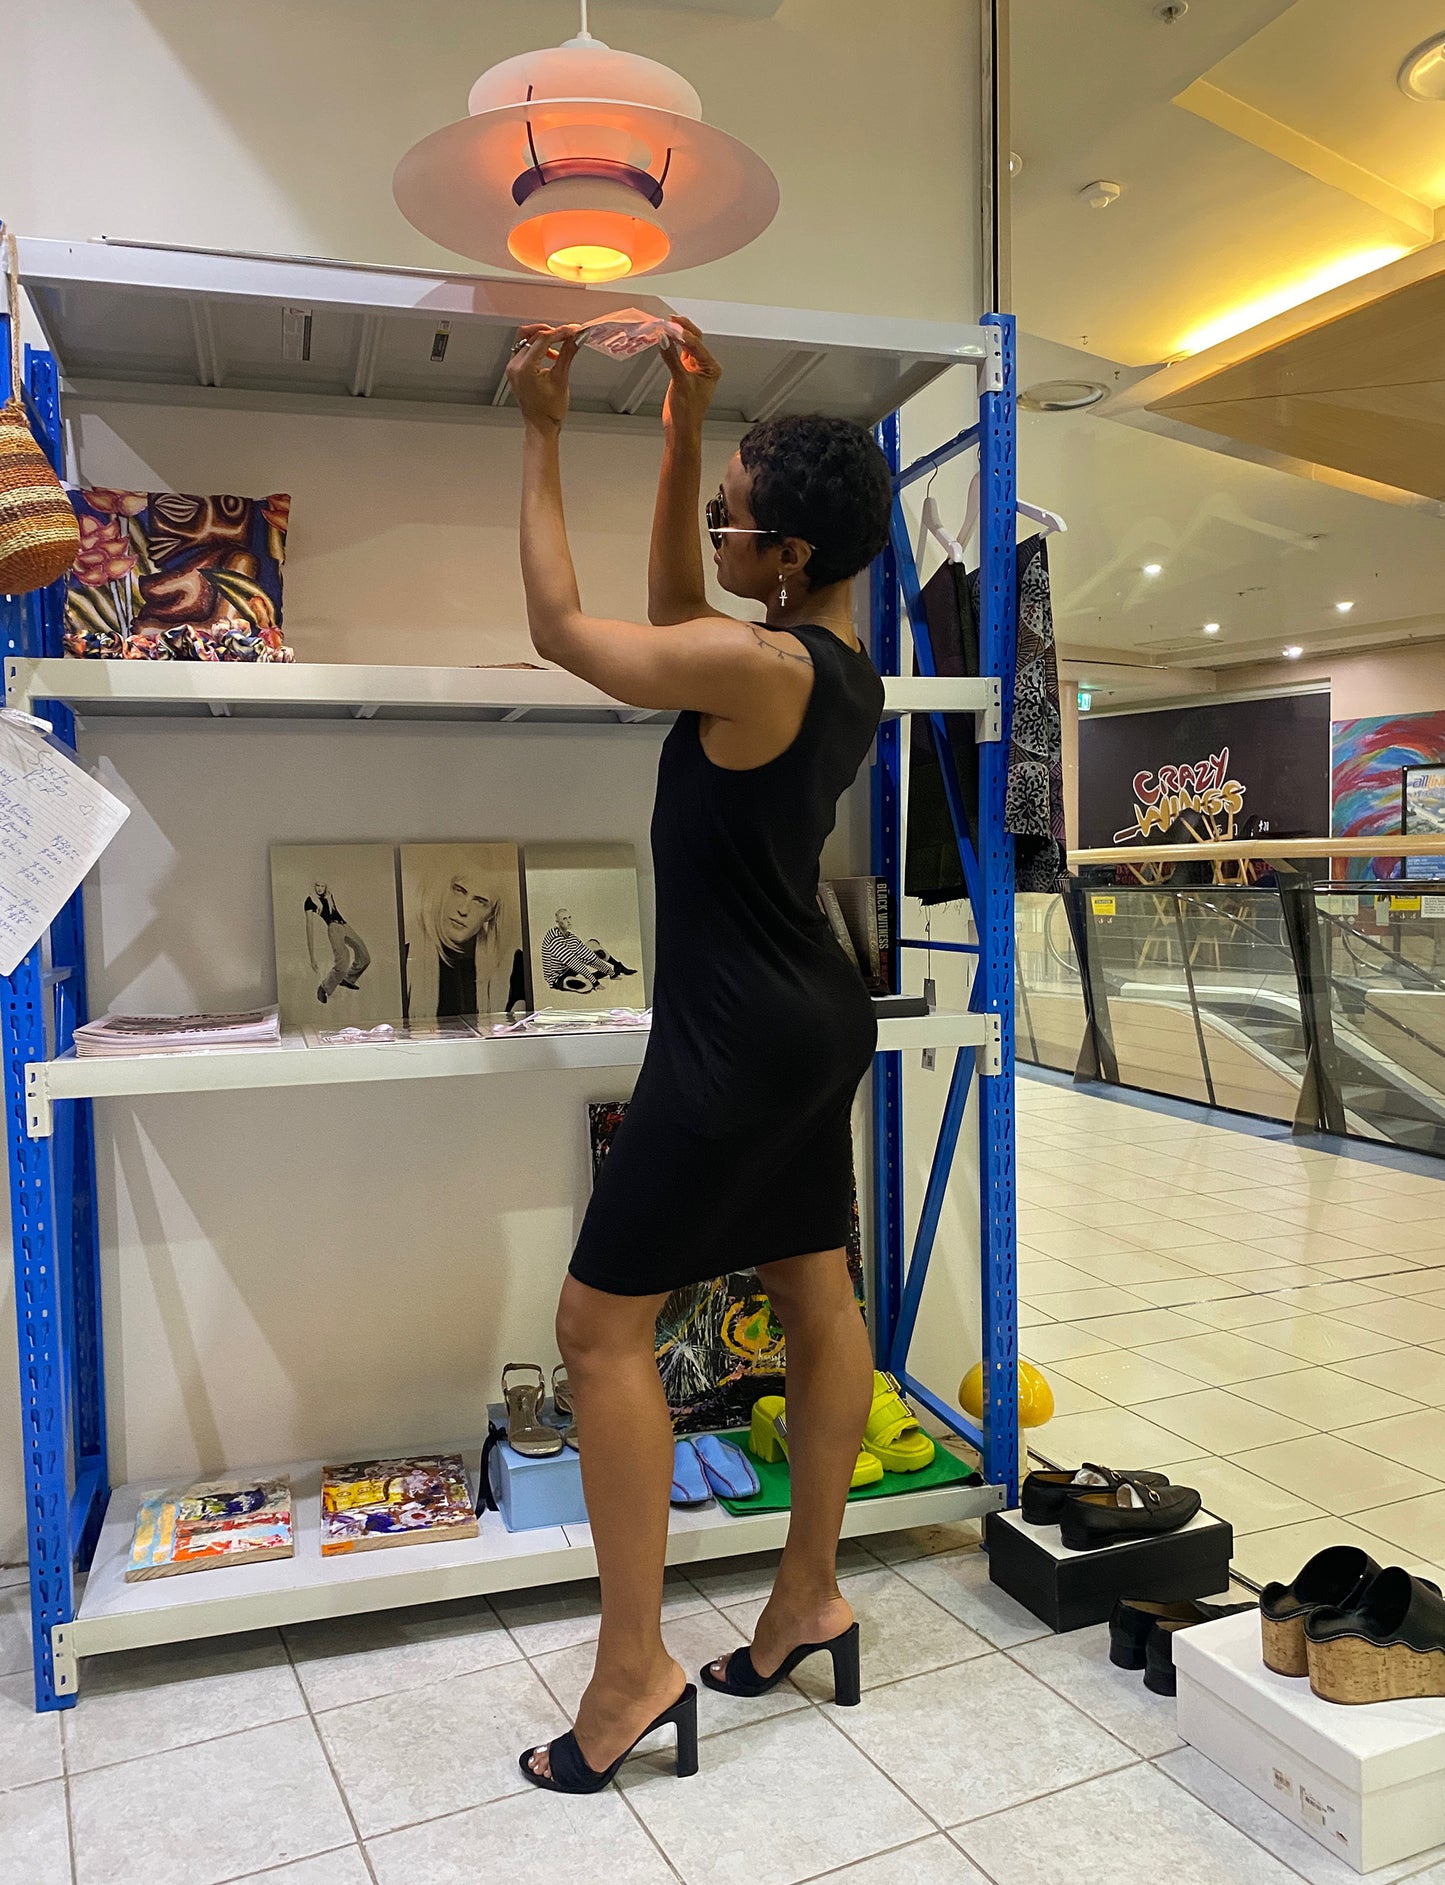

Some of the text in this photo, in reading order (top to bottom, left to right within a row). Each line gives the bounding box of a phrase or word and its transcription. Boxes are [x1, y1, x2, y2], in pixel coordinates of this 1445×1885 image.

[1132, 746, 1229, 806] CRAZY
[1133, 779, 1246, 838] WINGS
[876, 882, 888, 911] BLACK
[877, 911, 889, 950] WITNESS
